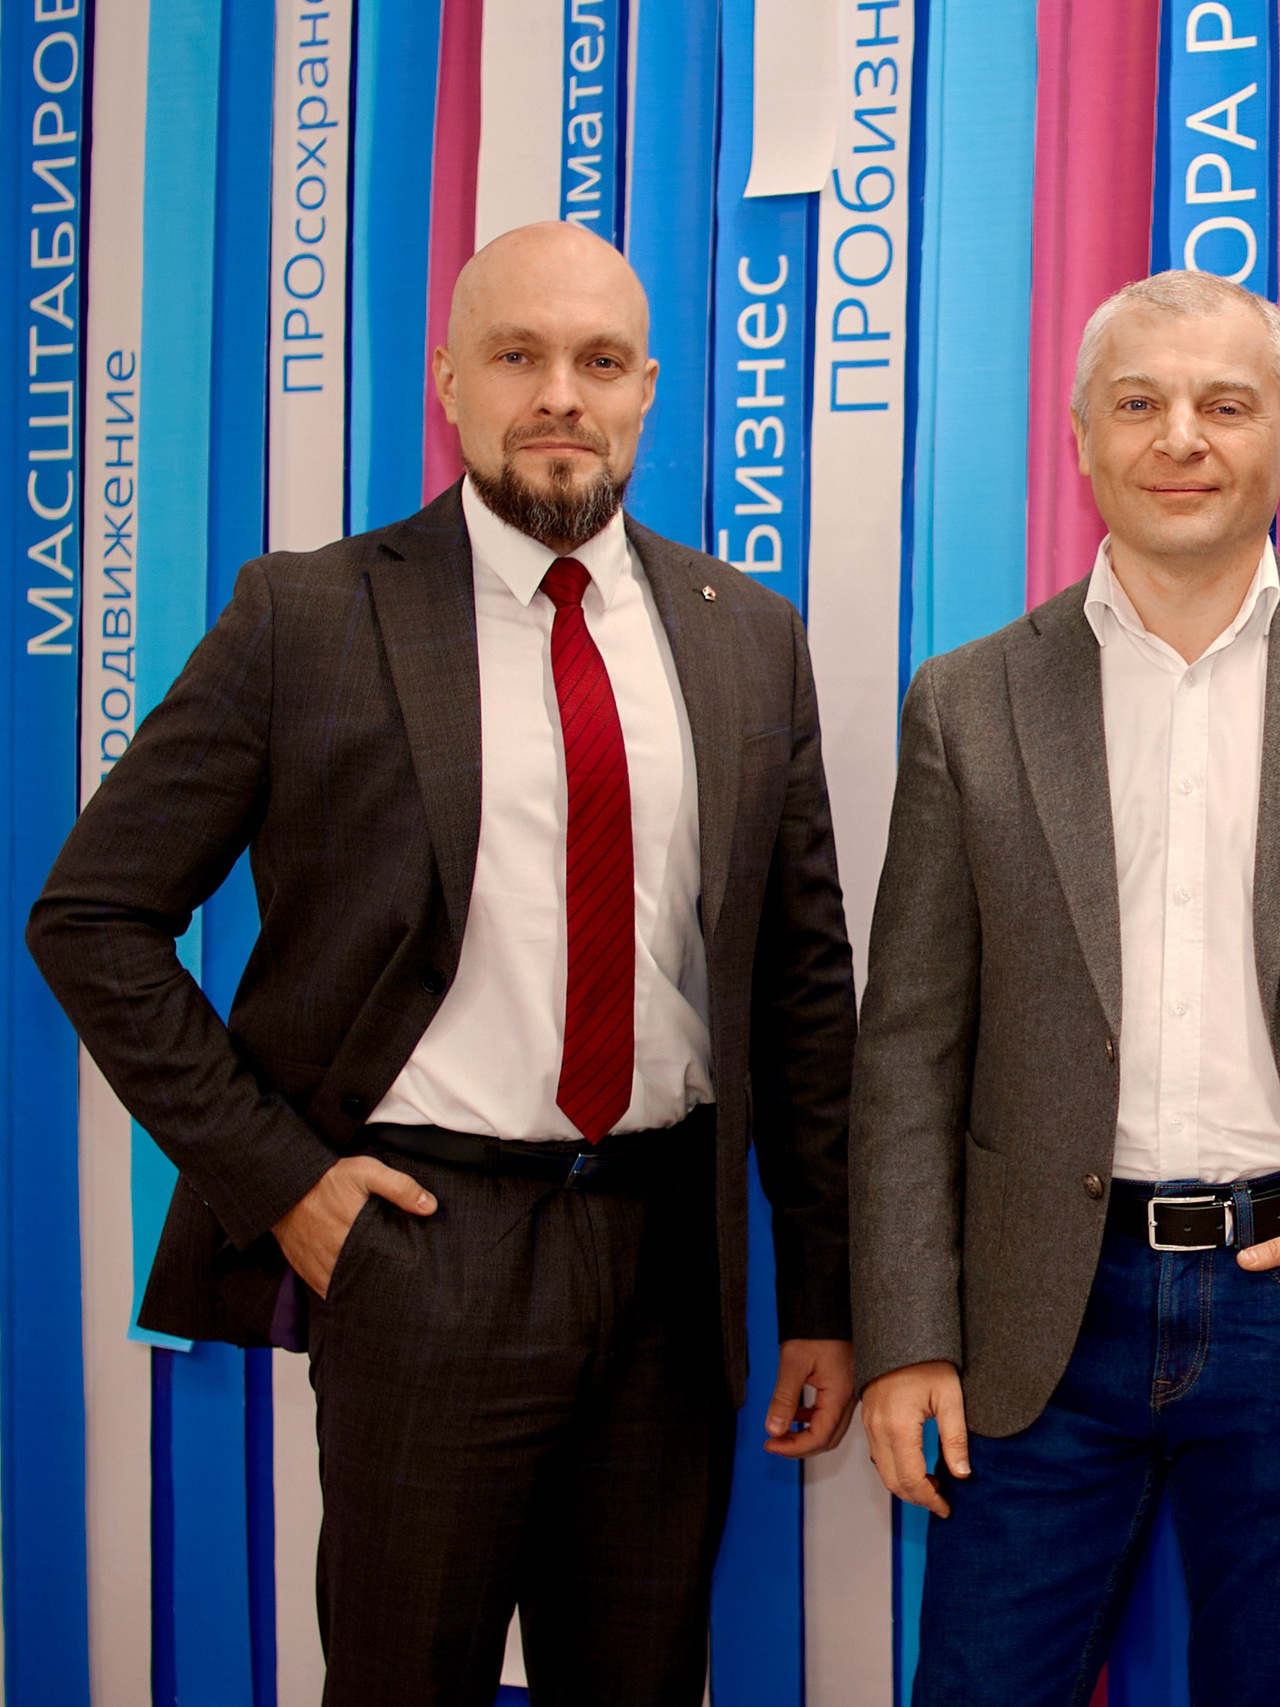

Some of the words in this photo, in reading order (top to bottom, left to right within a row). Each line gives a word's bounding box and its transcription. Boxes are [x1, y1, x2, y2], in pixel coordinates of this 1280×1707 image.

[282, 0, 339, 394] ПРОсохран
[830, 0, 900, 412] ПРОбизн
[100, 349, 136, 785] родвижение
[718, 254, 789, 573] Бизнес
